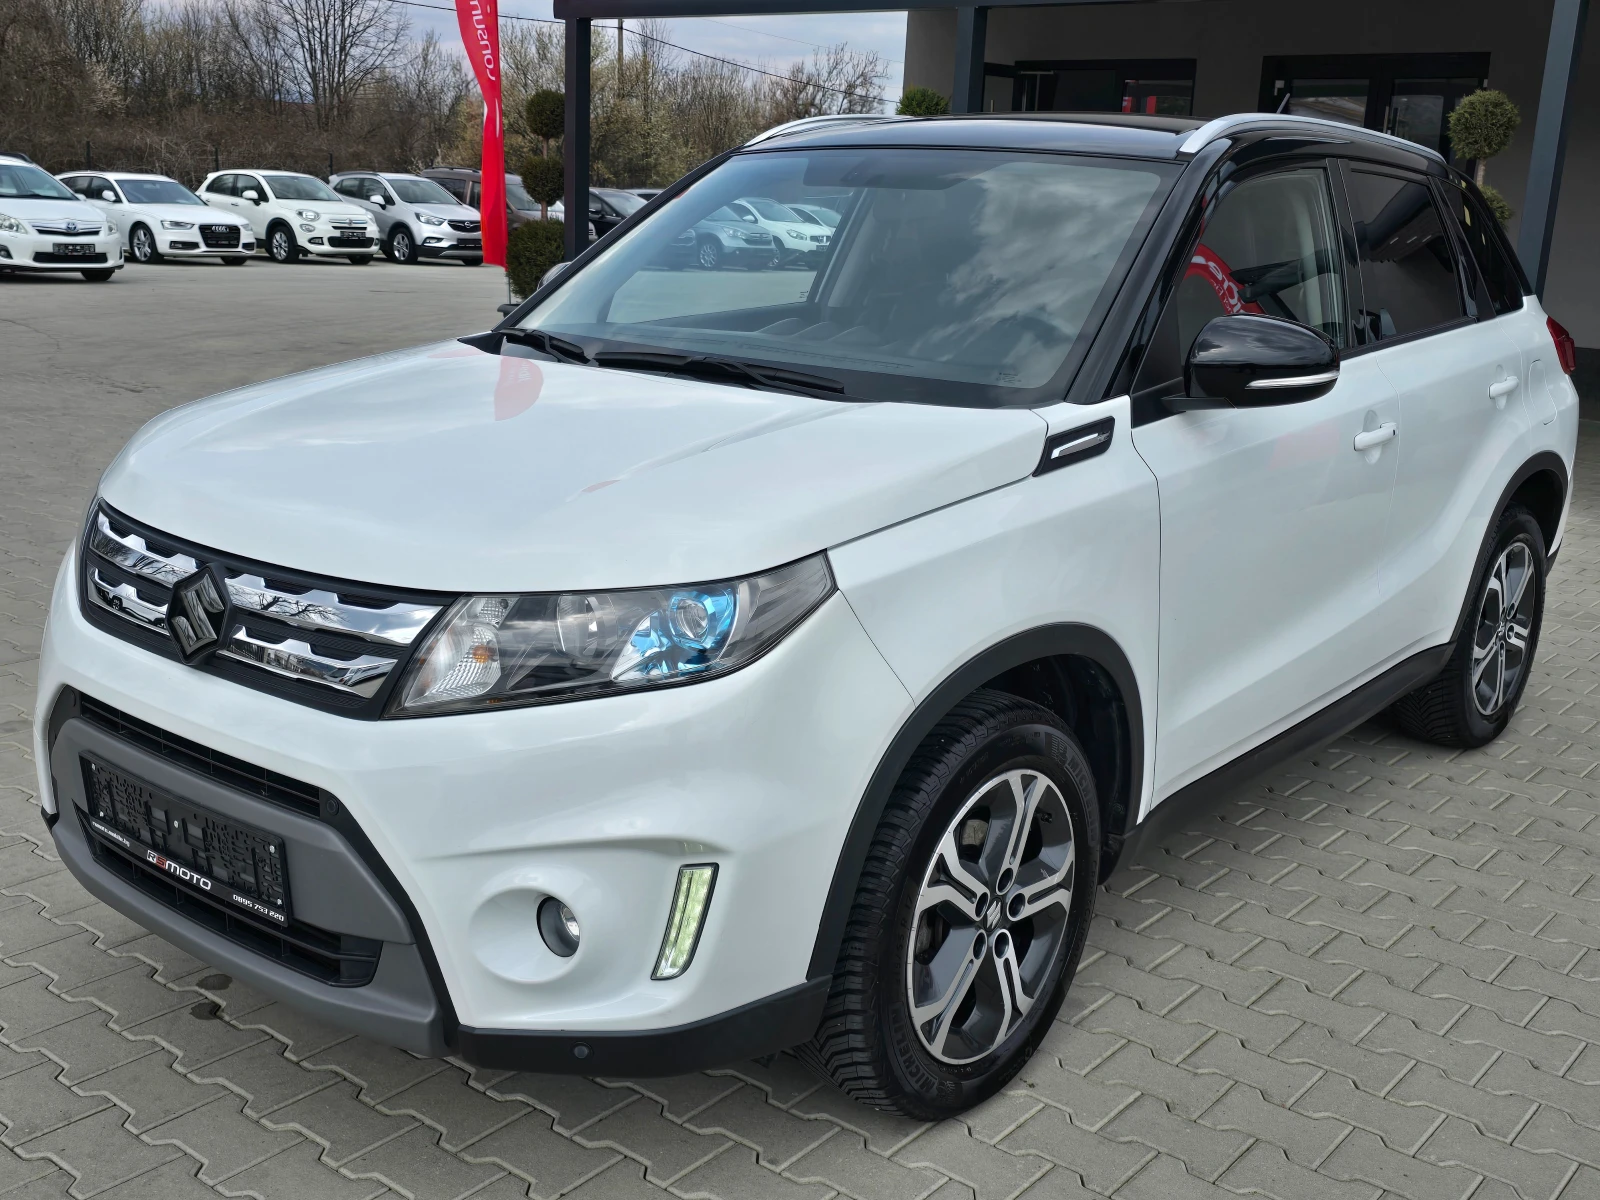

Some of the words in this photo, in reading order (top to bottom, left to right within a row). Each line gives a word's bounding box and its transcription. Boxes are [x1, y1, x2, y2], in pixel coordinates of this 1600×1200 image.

[232, 894, 253, 908] 0895
[254, 903, 268, 915] 753
[889, 1008, 936, 1094] MICHELIN
